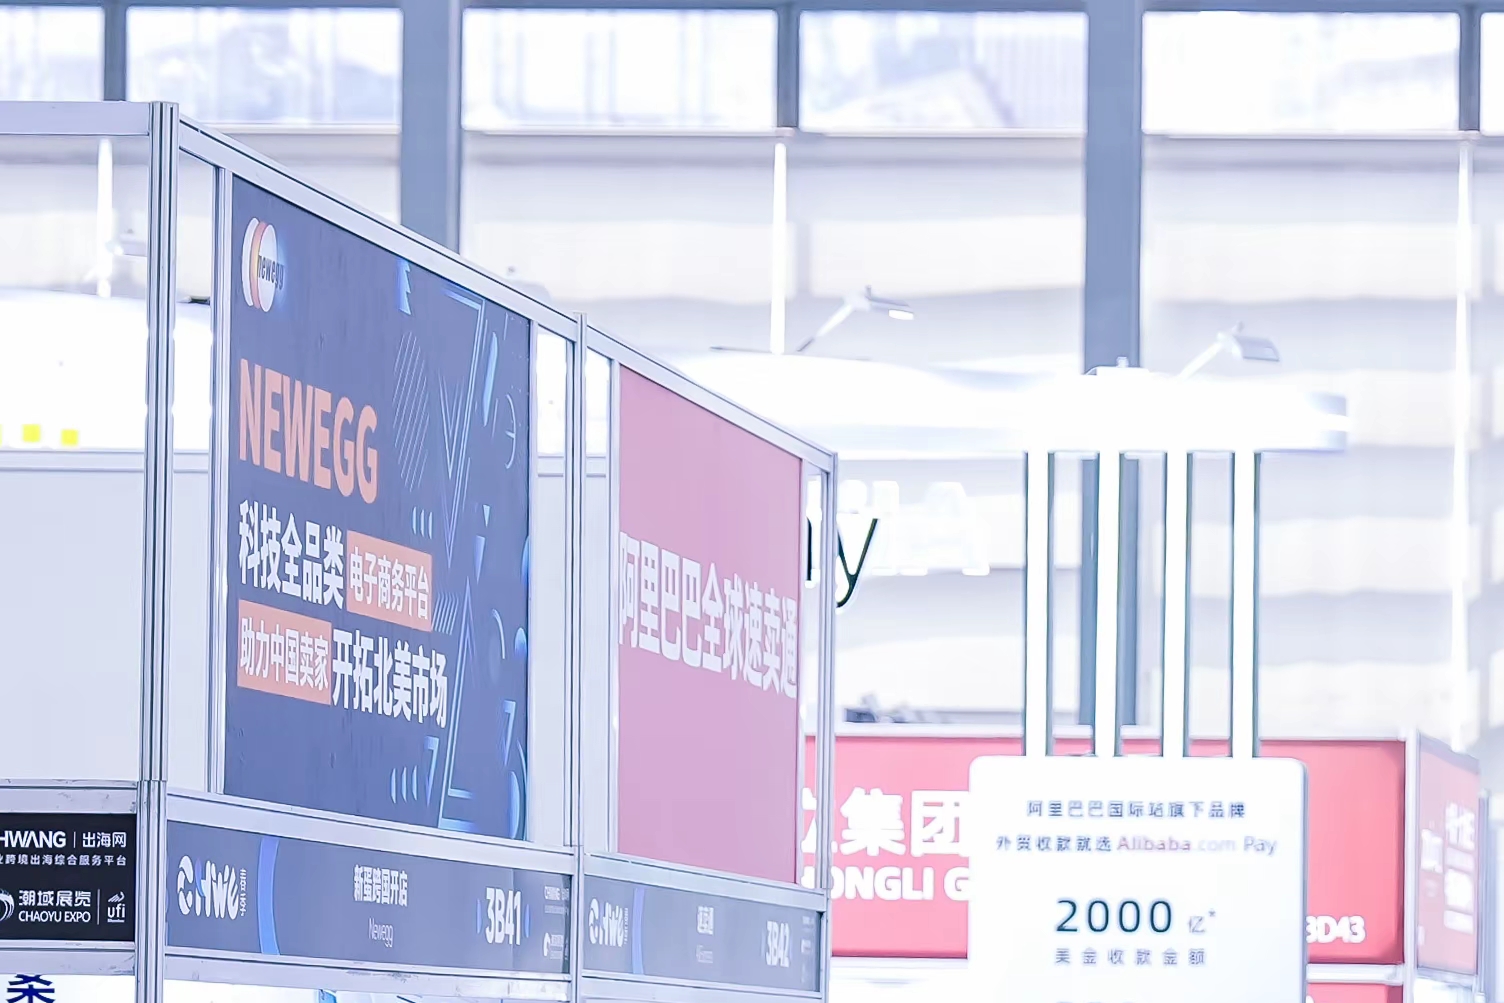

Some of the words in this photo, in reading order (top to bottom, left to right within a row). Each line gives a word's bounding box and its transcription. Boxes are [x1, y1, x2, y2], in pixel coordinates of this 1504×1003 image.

[257, 255, 285, 290] newegg
[239, 358, 378, 503] NEWEGG
[239, 500, 344, 609] 科技全品类
[350, 547, 429, 620] 电子商务平台
[619, 532, 798, 699] 阿里巴巴全球速卖通
[240, 617, 330, 690] 助力中国卖家
[333, 628, 448, 728] 开拓北美市场
[1027, 801, 1246, 818] 阿里巴巴国际站旗下品牌
[83, 832, 126, 848] 出海网
[996, 835, 1112, 852] 外贸收款就选
[1244, 836, 1277, 855] Pay
[19, 890, 91, 907] 潮域展览
[107, 903, 125, 918] ufi
[18, 910, 61, 923] CHAOYU
[64, 911, 91, 923] EXPO
[485, 886, 521, 946] 3B41
[1056, 899, 1172, 932] 2000
[1305, 915, 1366, 944] 3D43
[368, 918, 393, 948] Newegg
[765, 920, 790, 968] 3B42
[1055, 948, 1207, 965] 美金收款金额
